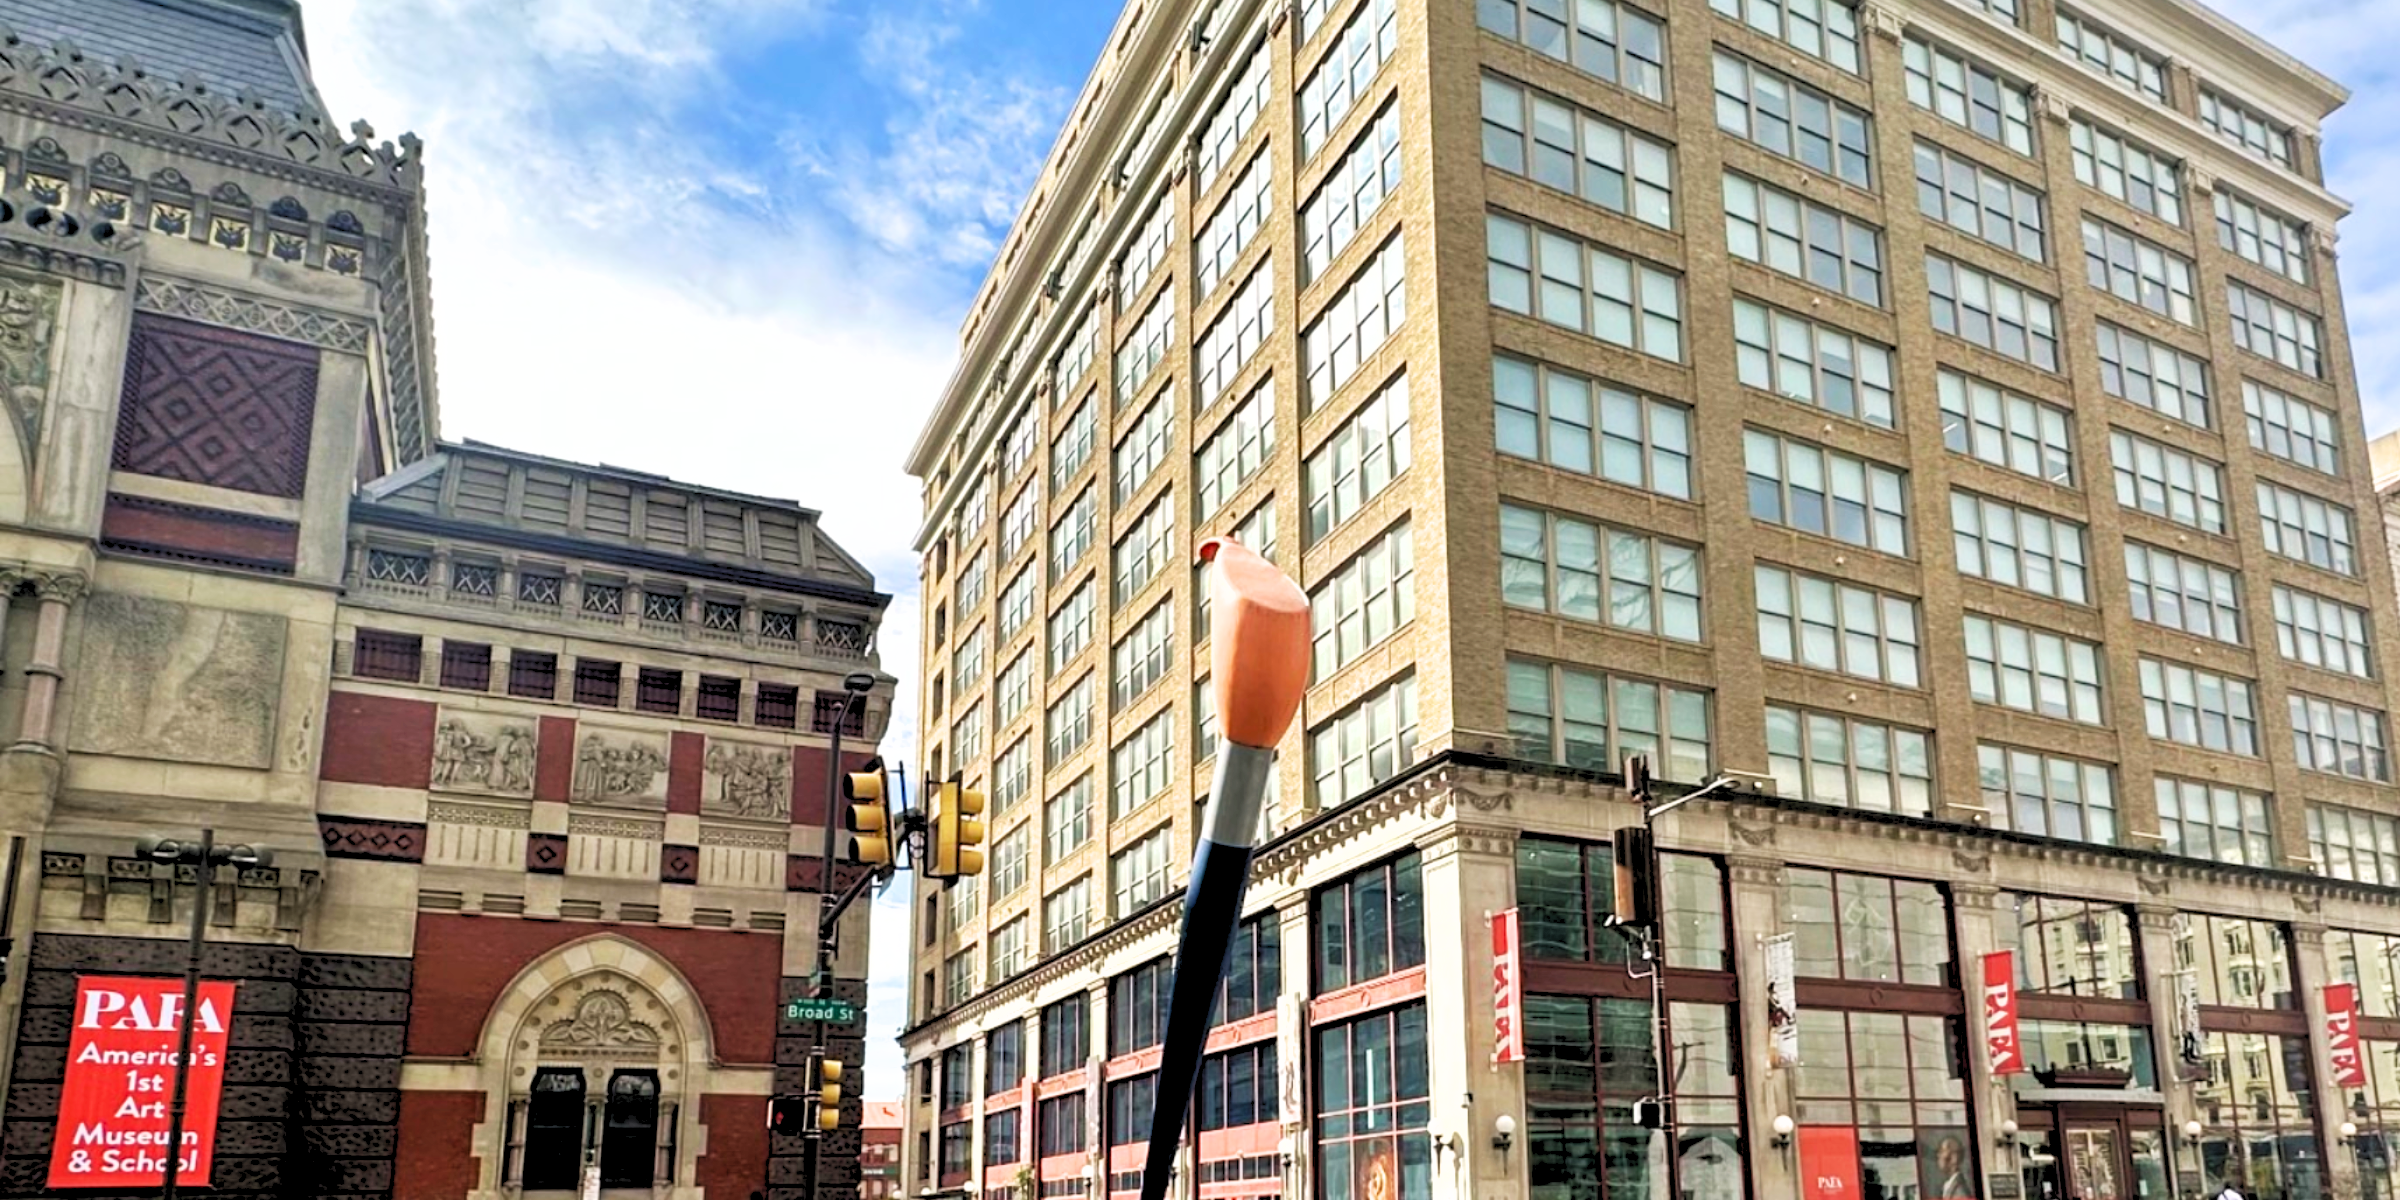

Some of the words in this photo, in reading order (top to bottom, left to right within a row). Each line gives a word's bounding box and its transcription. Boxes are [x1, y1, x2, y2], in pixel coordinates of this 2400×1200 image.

[78, 989, 224, 1033] PAFA
[788, 1005, 834, 1020] Broad
[839, 1008, 854, 1021] St
[1984, 982, 2013, 1069] PAFA
[2326, 1010, 2356, 1082] PAFA
[126, 1069, 164, 1092] 1st
[114, 1096, 165, 1118] Art
[68, 1149, 92, 1173] &
